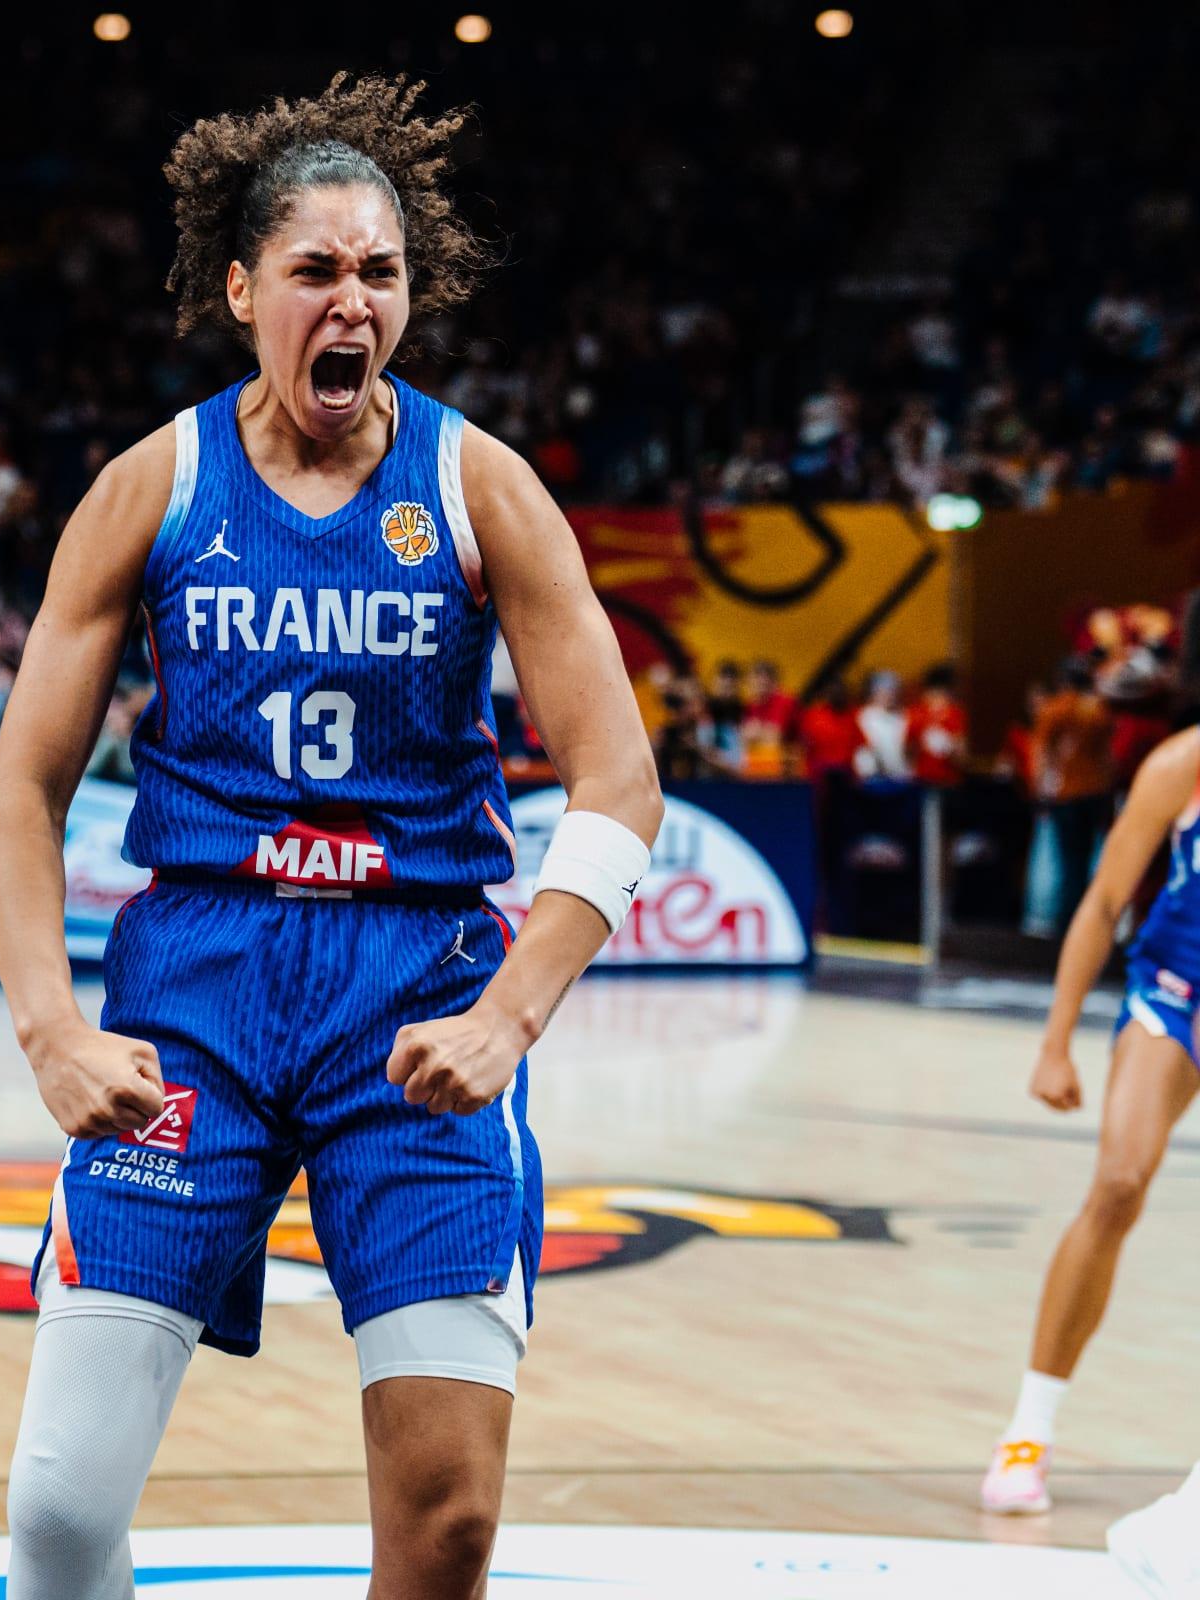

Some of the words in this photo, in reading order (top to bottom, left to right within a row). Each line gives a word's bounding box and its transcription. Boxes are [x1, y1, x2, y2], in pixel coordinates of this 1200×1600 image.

[186, 586, 444, 657] FRANCE
[257, 690, 357, 780] 13
[255, 834, 385, 882] MAIF
[88, 1160, 195, 1197] D'EPARGNE
[114, 1148, 179, 1175] CAISSE
